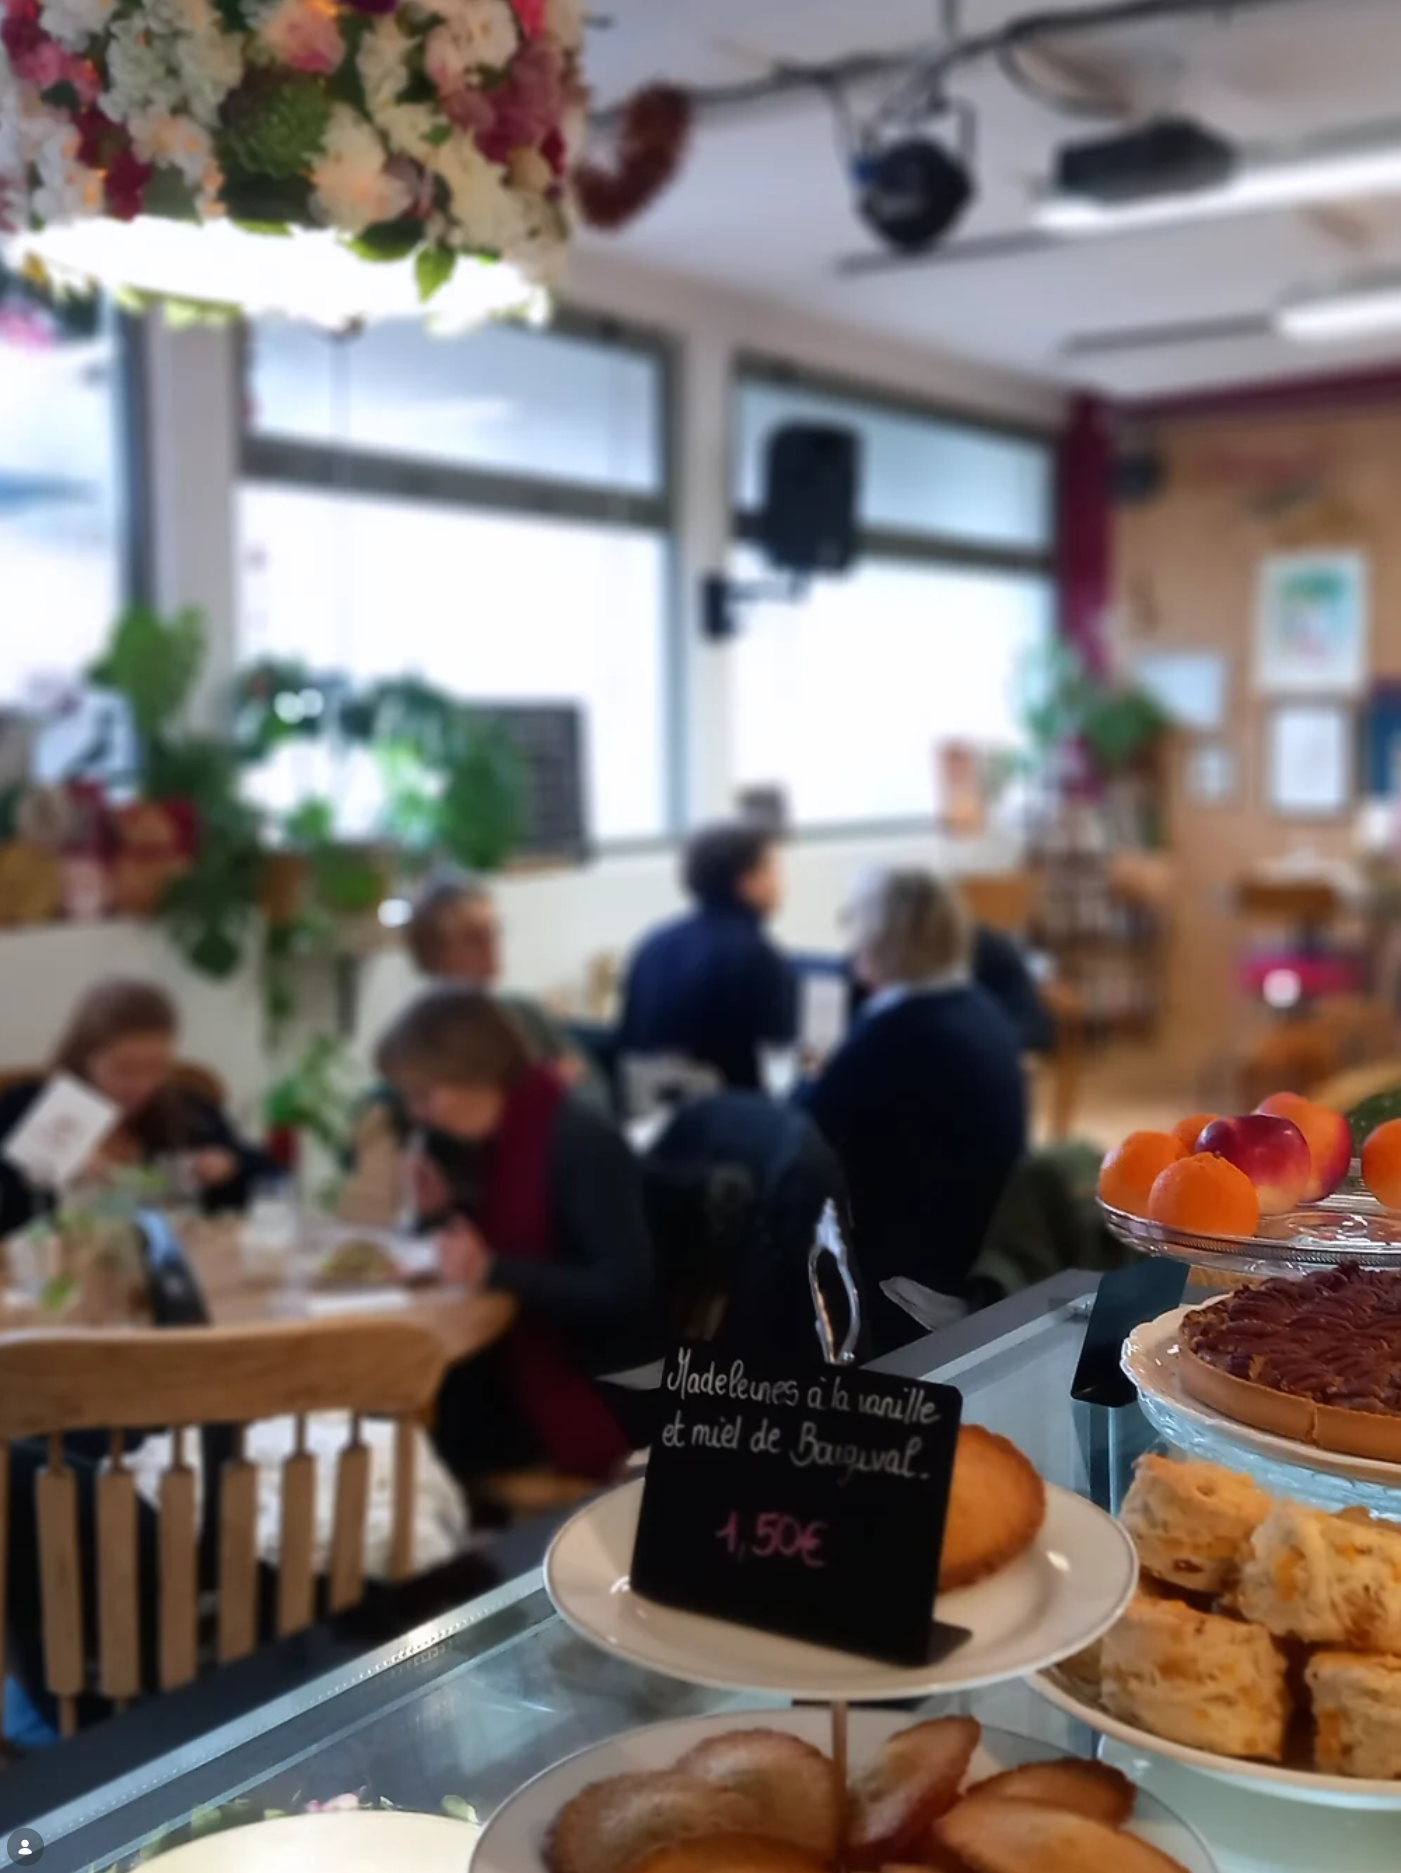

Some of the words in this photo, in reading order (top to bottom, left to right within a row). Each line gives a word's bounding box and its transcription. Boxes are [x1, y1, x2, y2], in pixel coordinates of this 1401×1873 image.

[666, 1347, 799, 1406] Madeleines
[808, 1376, 828, 1408] à
[831, 1376, 850, 1411] la
[858, 1387, 941, 1424] vanille
[662, 1410, 686, 1446] et
[691, 1416, 741, 1448] miel
[749, 1418, 781, 1453] de
[715, 1511, 828, 1567] 1,50€
